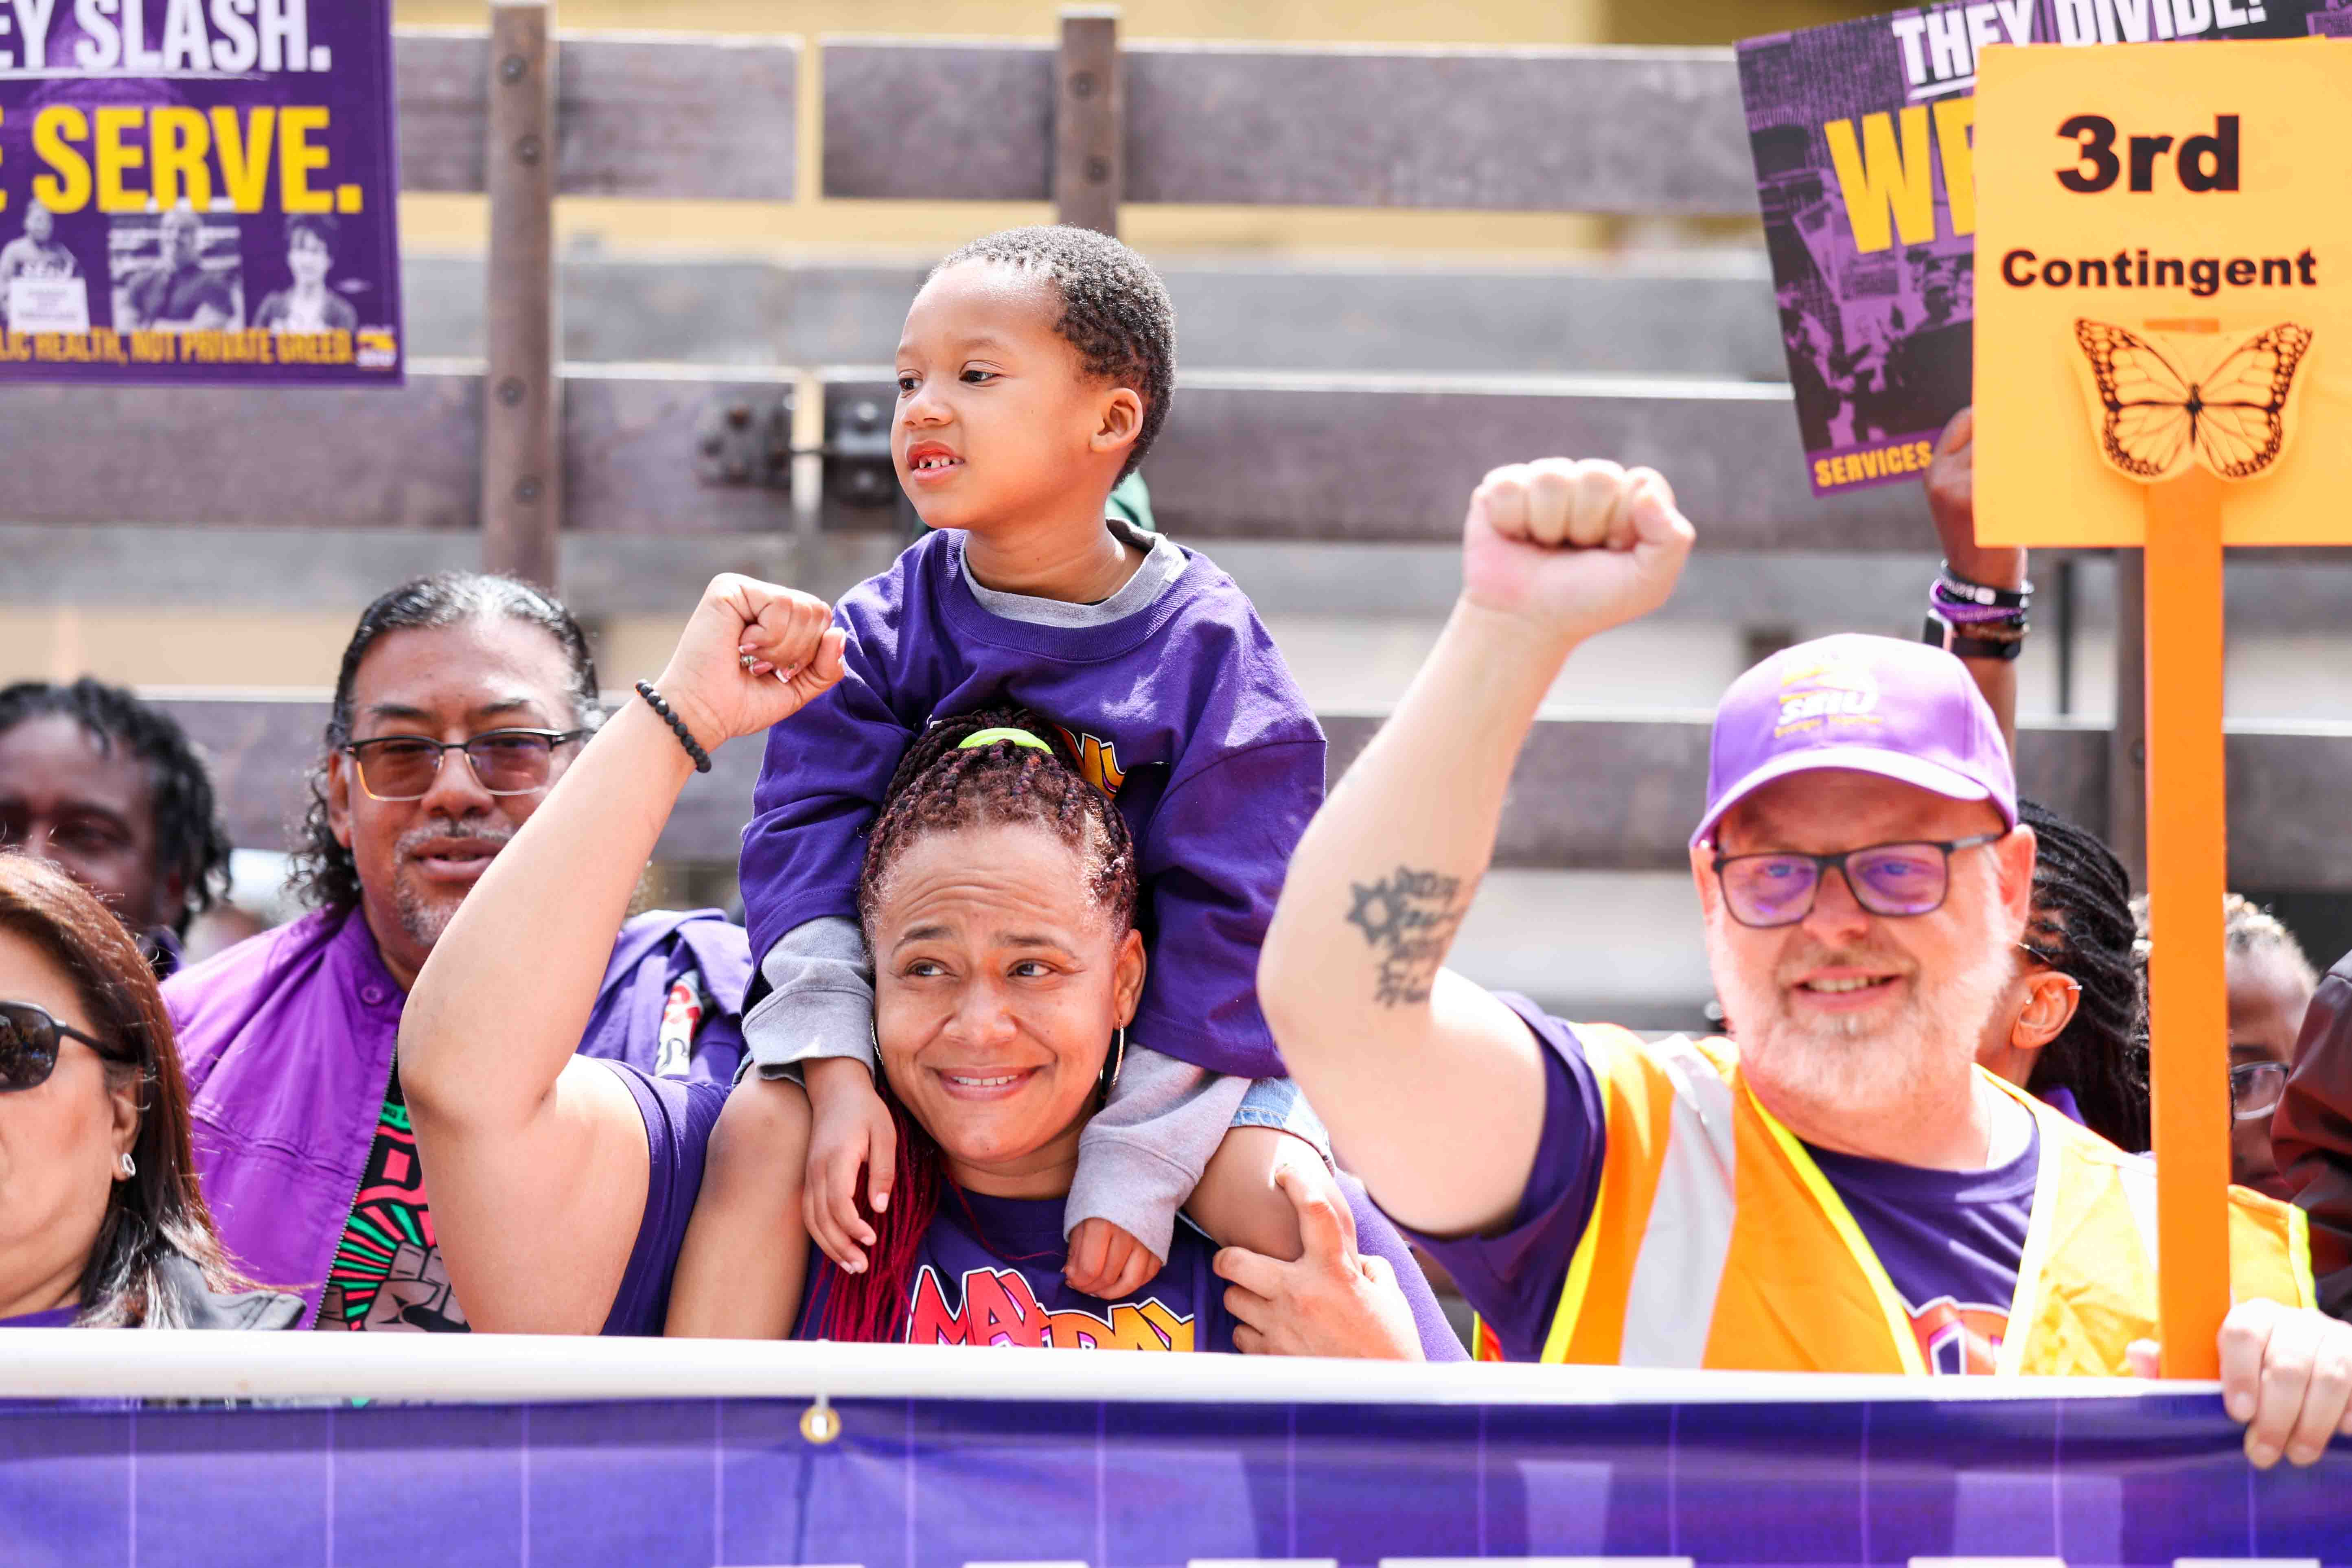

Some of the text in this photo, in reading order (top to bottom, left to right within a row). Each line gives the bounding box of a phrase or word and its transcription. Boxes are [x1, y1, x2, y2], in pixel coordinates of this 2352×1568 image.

[74, 0, 331, 72] SLASH.
[32, 104, 363, 213] SERVE.
[2055, 114, 2240, 194] 3rd
[2000, 247, 2317, 297] Contingent
[1814, 440, 1933, 487] SERVICES
